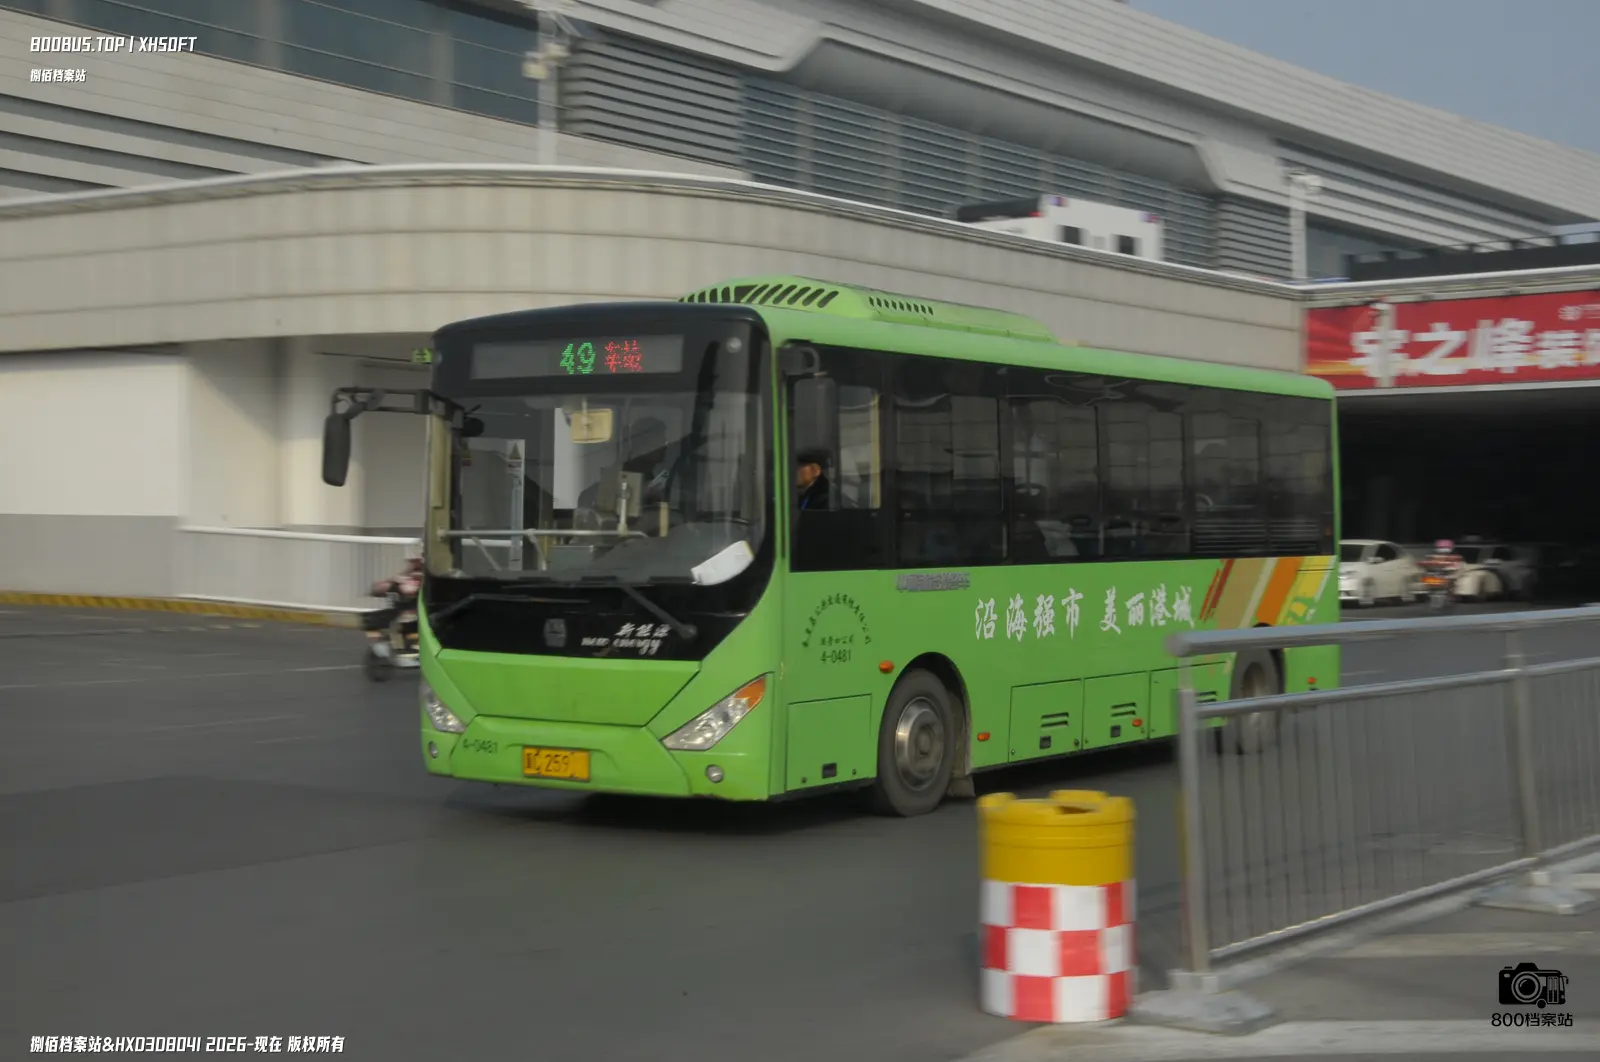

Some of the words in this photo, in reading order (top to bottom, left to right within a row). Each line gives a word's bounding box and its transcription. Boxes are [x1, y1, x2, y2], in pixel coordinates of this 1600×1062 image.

[560, 342, 596, 375] 49
[975, 588, 1084, 641] 沿海强市
[1100, 584, 1195, 634] 美丽港城
